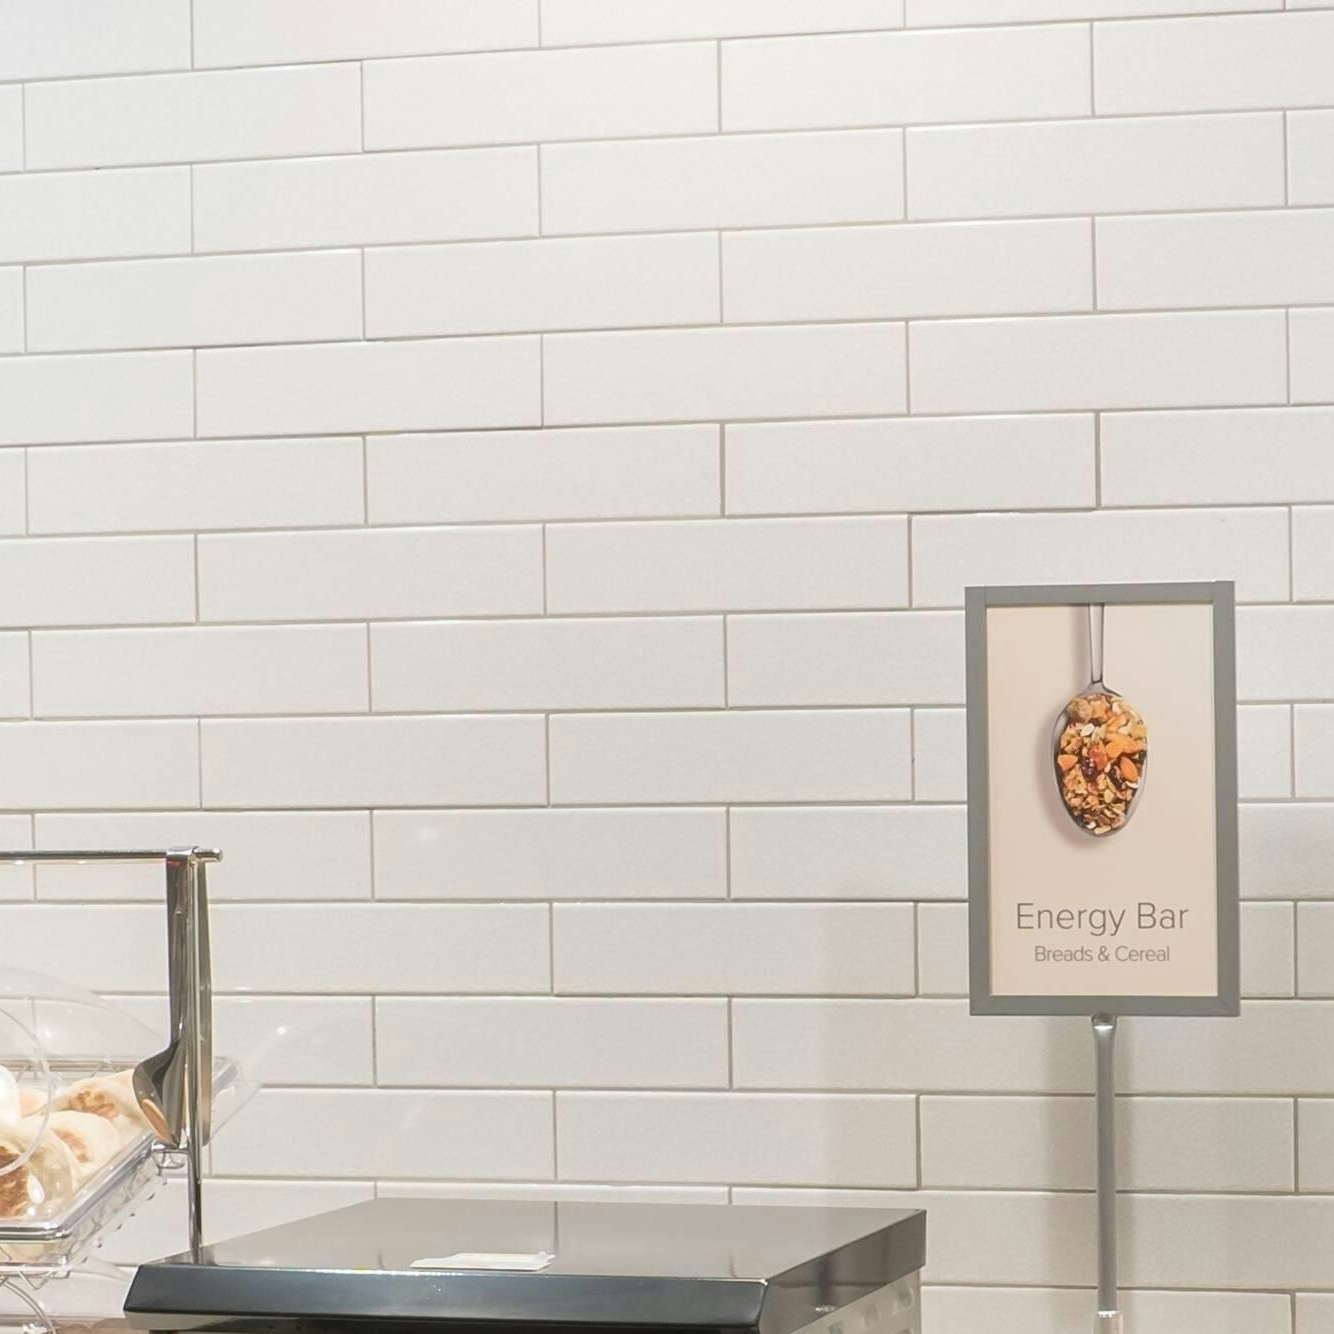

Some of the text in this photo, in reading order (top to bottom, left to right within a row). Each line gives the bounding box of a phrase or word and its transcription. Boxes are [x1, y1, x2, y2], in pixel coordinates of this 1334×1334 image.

[1016, 901, 1190, 937] Energy Bar
[1033, 944, 1171, 963] Breads & Cereal
